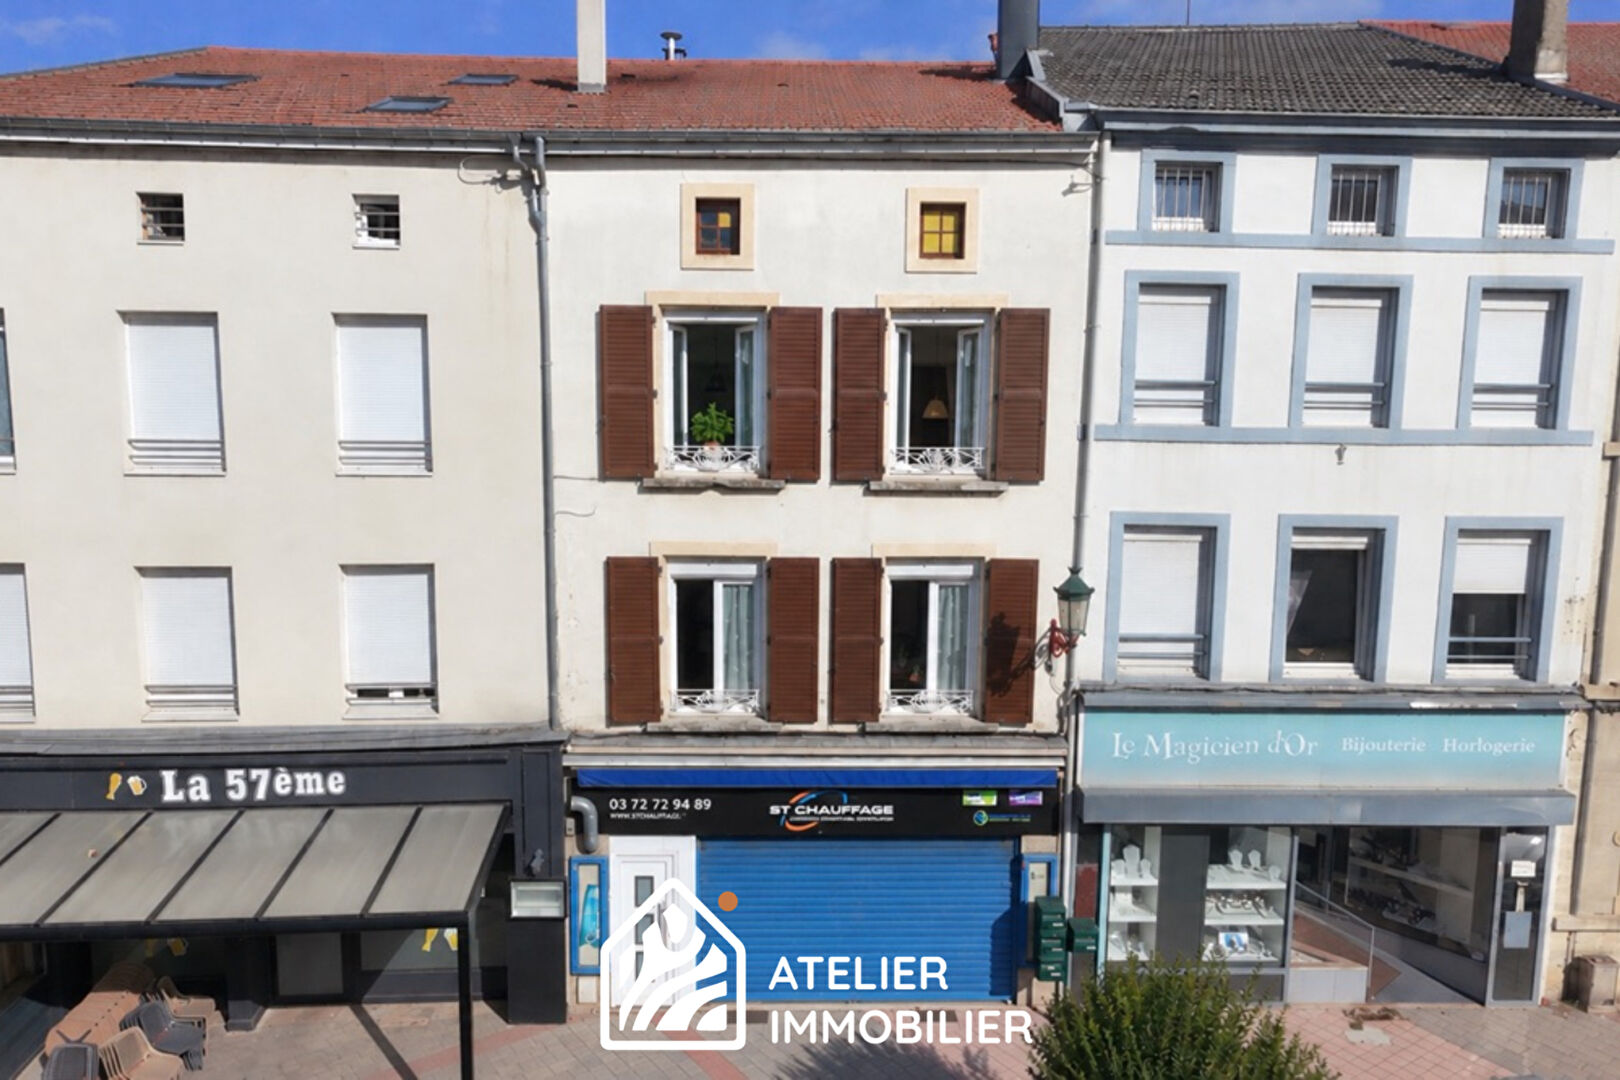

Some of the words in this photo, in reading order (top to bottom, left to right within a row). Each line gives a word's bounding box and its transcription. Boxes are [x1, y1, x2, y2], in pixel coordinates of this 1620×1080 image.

[1112, 732, 1135, 760] Le
[1143, 732, 1259, 764] Magicien
[1267, 730, 1319, 756] d'Or
[1340, 735, 1427, 757] Bijouterie
[1441, 736, 1537, 757] Horlogerie
[161, 768, 212, 803] La
[225, 766, 346, 803] 57ème
[608, 798, 627, 811] 03
[631, 798, 648, 811] 72
[652, 798, 669, 811] 72
[672, 798, 690, 811] 94
[693, 798, 712, 811] 89
[769, 805, 791, 815] ST
[794, 805, 894, 815] CHAUFFAGE
